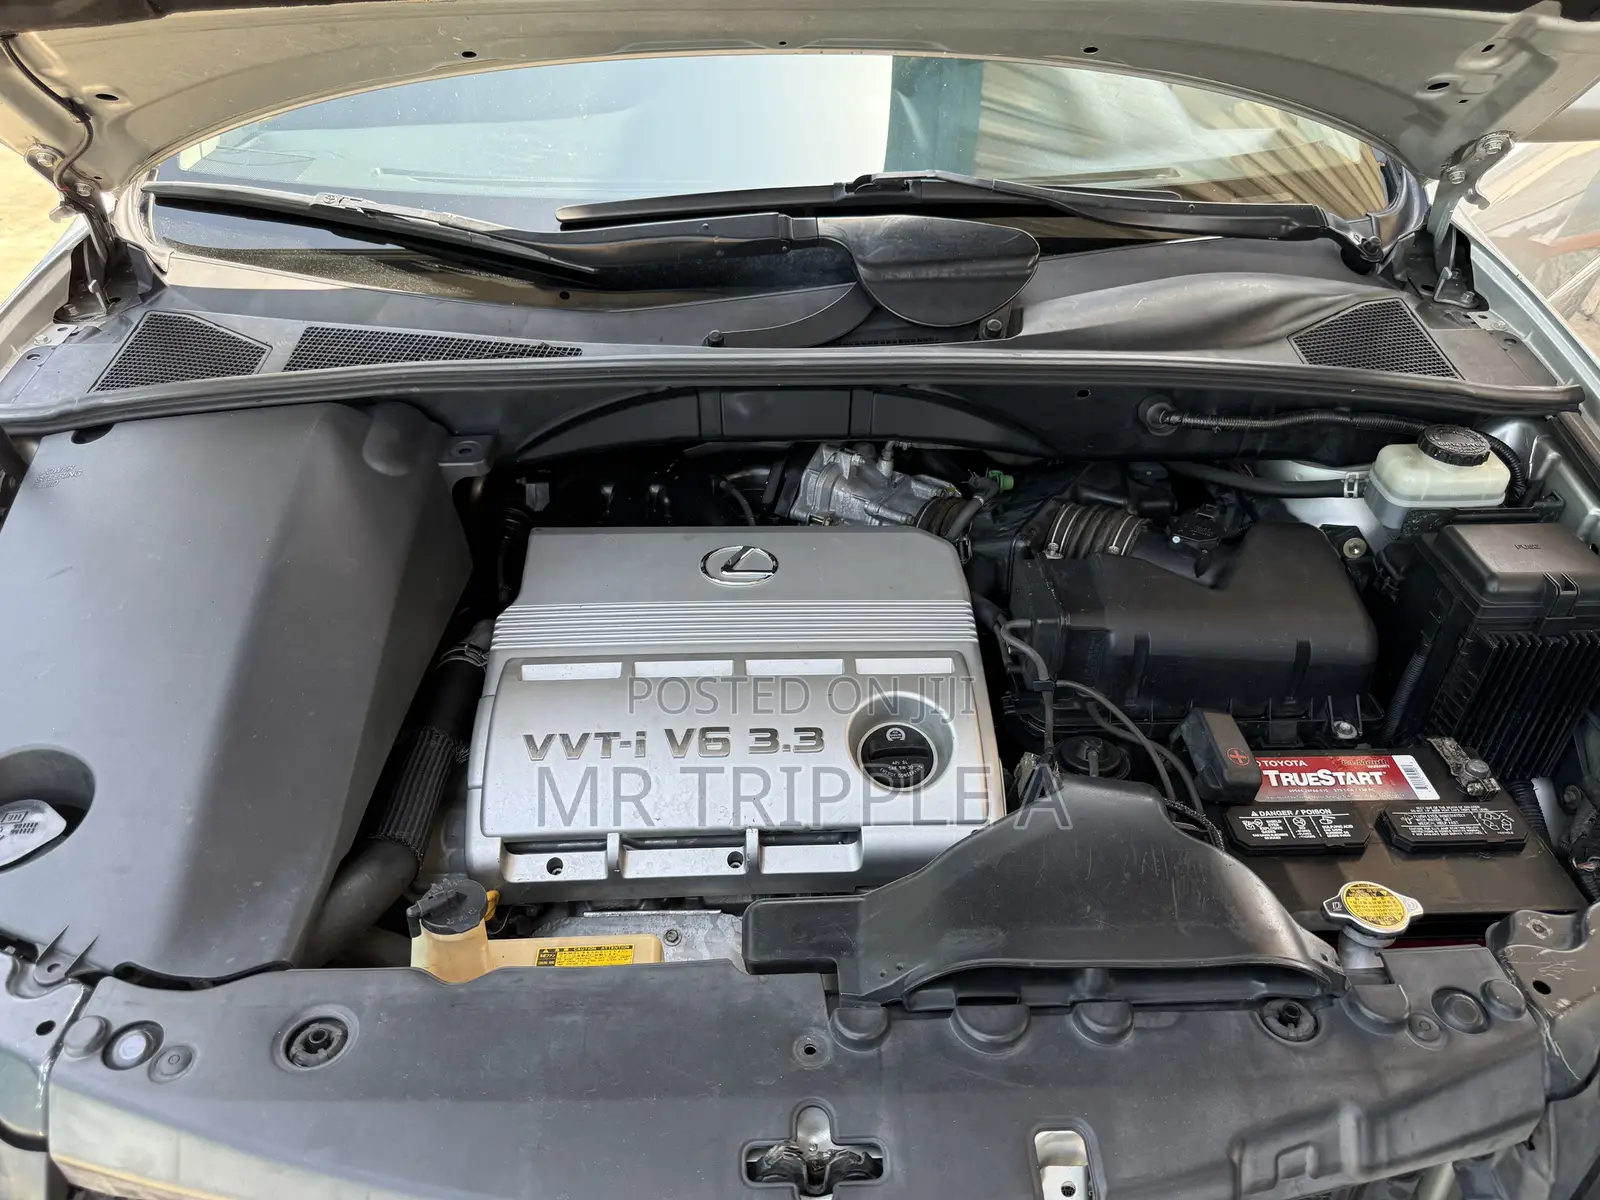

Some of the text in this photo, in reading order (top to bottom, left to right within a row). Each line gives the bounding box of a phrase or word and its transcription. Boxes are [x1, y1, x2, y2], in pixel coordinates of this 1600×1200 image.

[522, 726, 825, 761] VVT-i V6 3.3
[1261, 759, 1308, 767] TOYOTA
